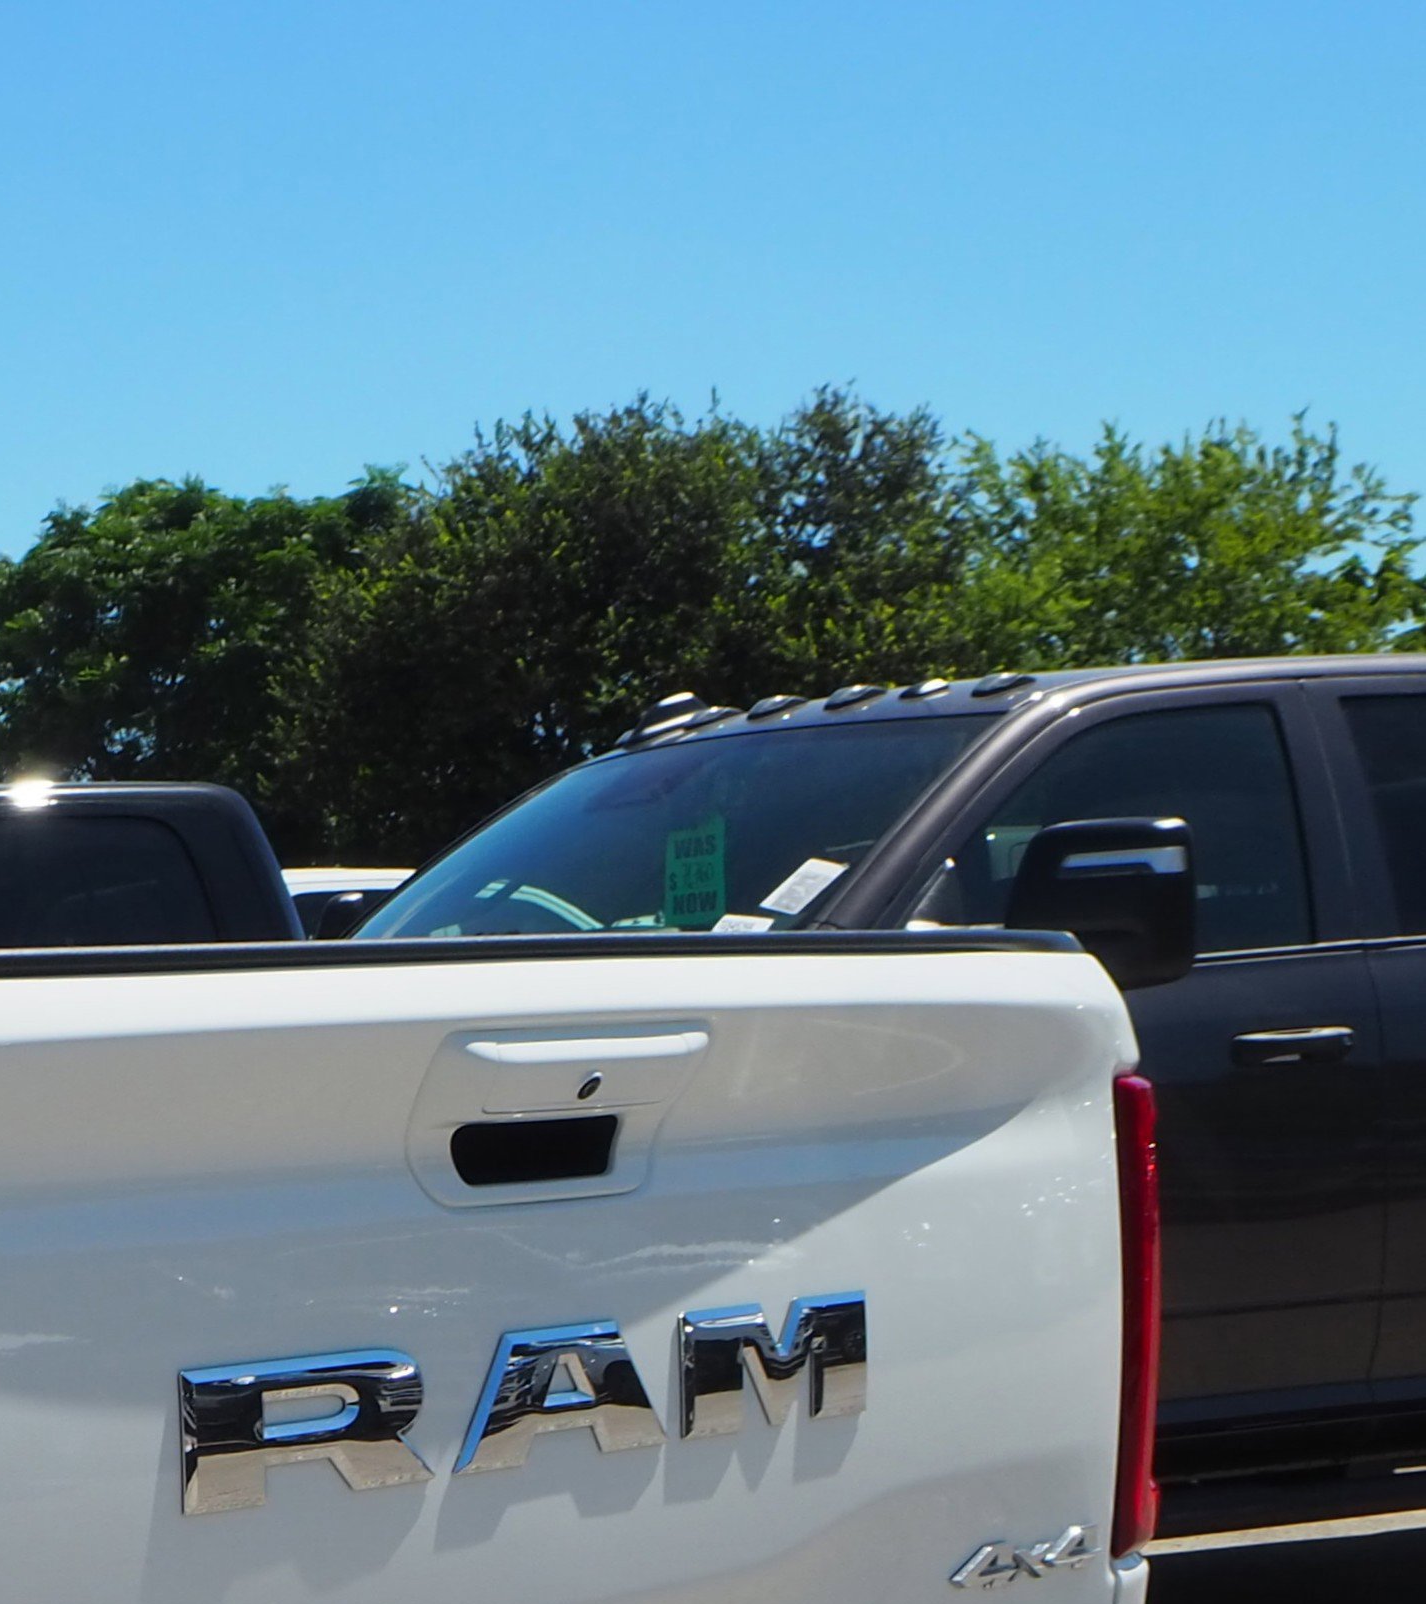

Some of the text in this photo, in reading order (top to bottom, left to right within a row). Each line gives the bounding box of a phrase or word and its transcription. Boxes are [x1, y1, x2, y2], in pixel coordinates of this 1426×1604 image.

[674, 834, 716, 859] WAS
[673, 891, 718, 915] NOW
[180, 1290, 867, 1515] RAM
